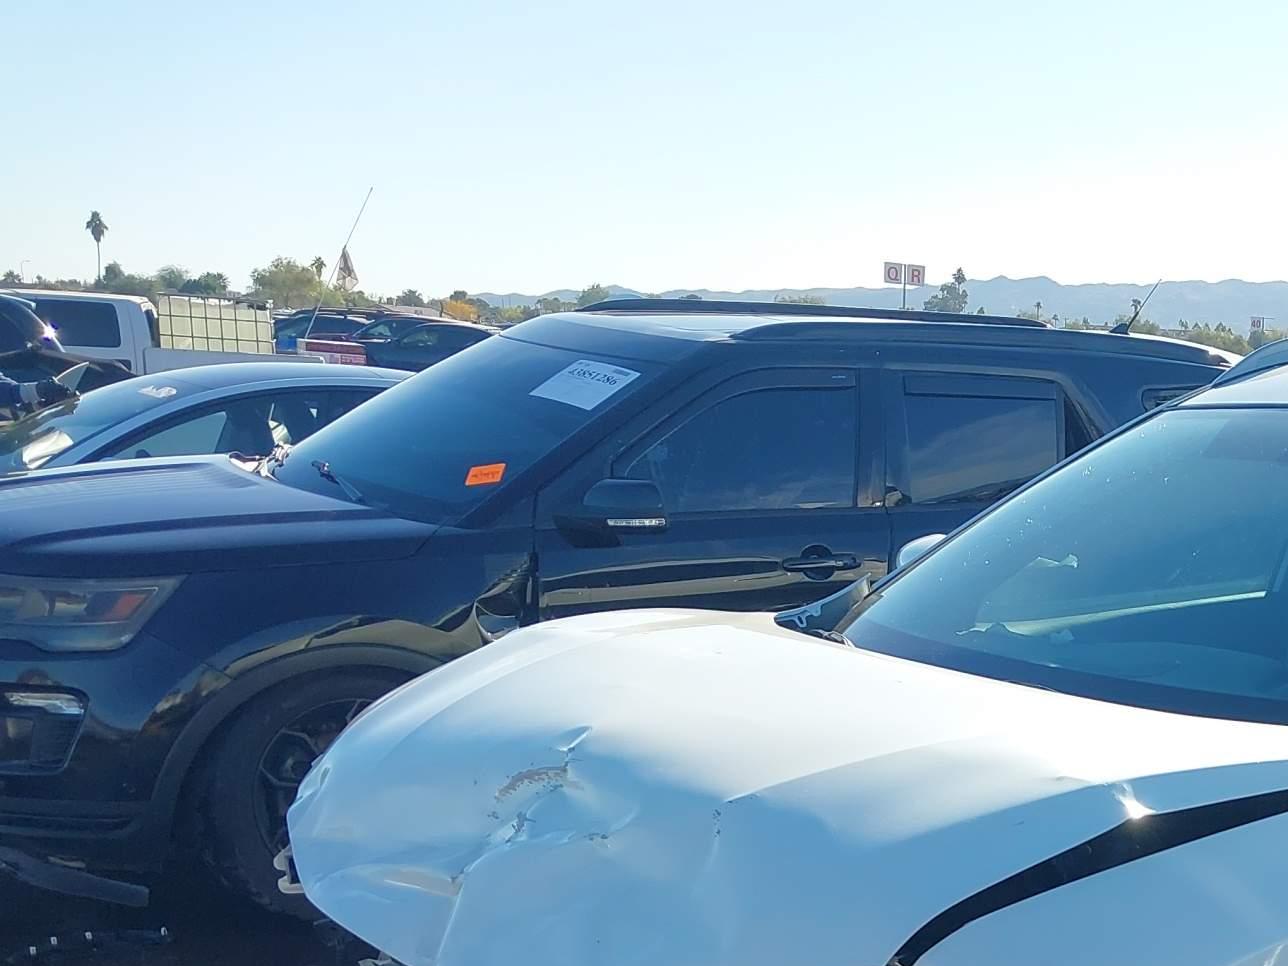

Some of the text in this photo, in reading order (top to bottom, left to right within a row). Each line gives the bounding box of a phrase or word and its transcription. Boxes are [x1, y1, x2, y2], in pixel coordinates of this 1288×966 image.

[887, 266, 900, 281] Q
[911, 268, 921, 283] R
[567, 367, 621, 386] 43851286
